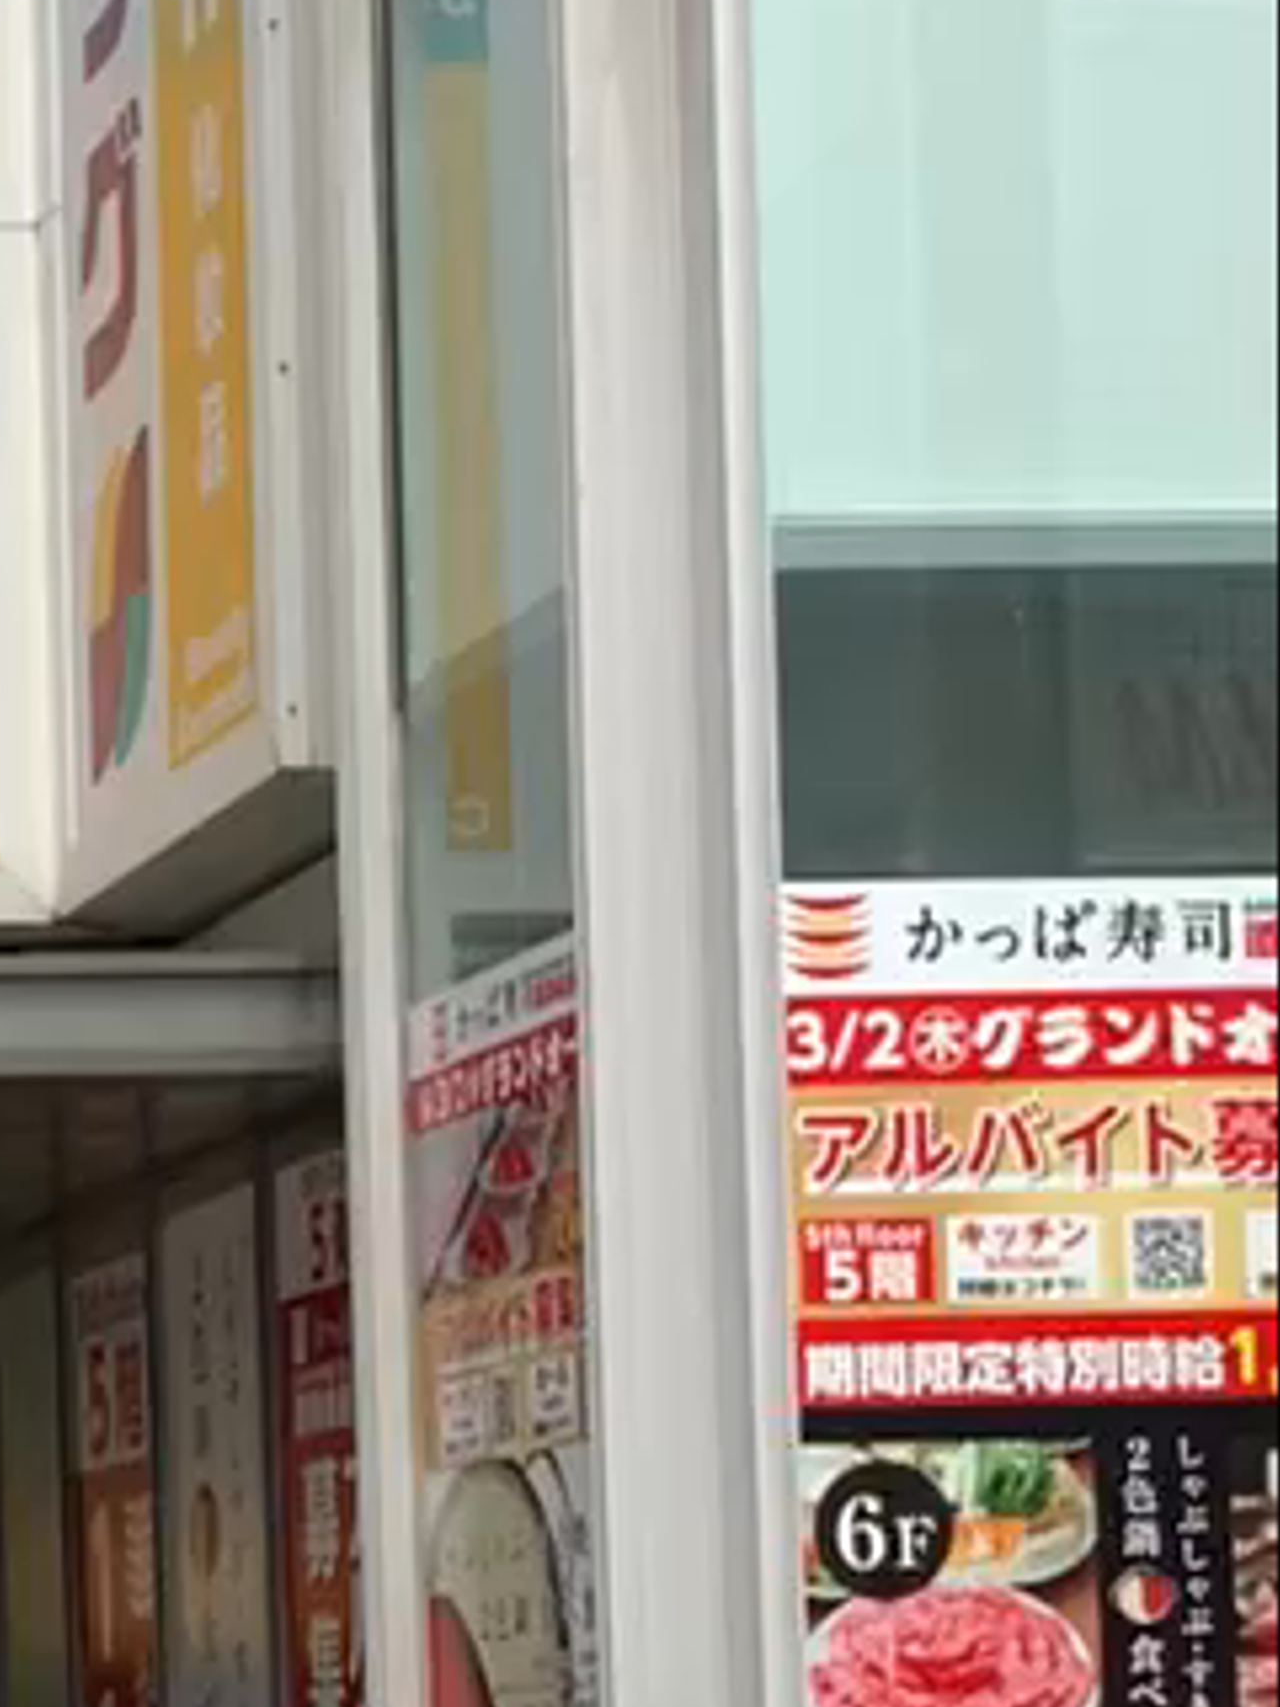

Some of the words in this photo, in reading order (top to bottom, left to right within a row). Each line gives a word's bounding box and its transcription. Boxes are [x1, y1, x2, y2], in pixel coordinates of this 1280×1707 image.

[904, 900, 1233, 963] かっぱ寿司
[835, 1493, 934, 1571] 6F
